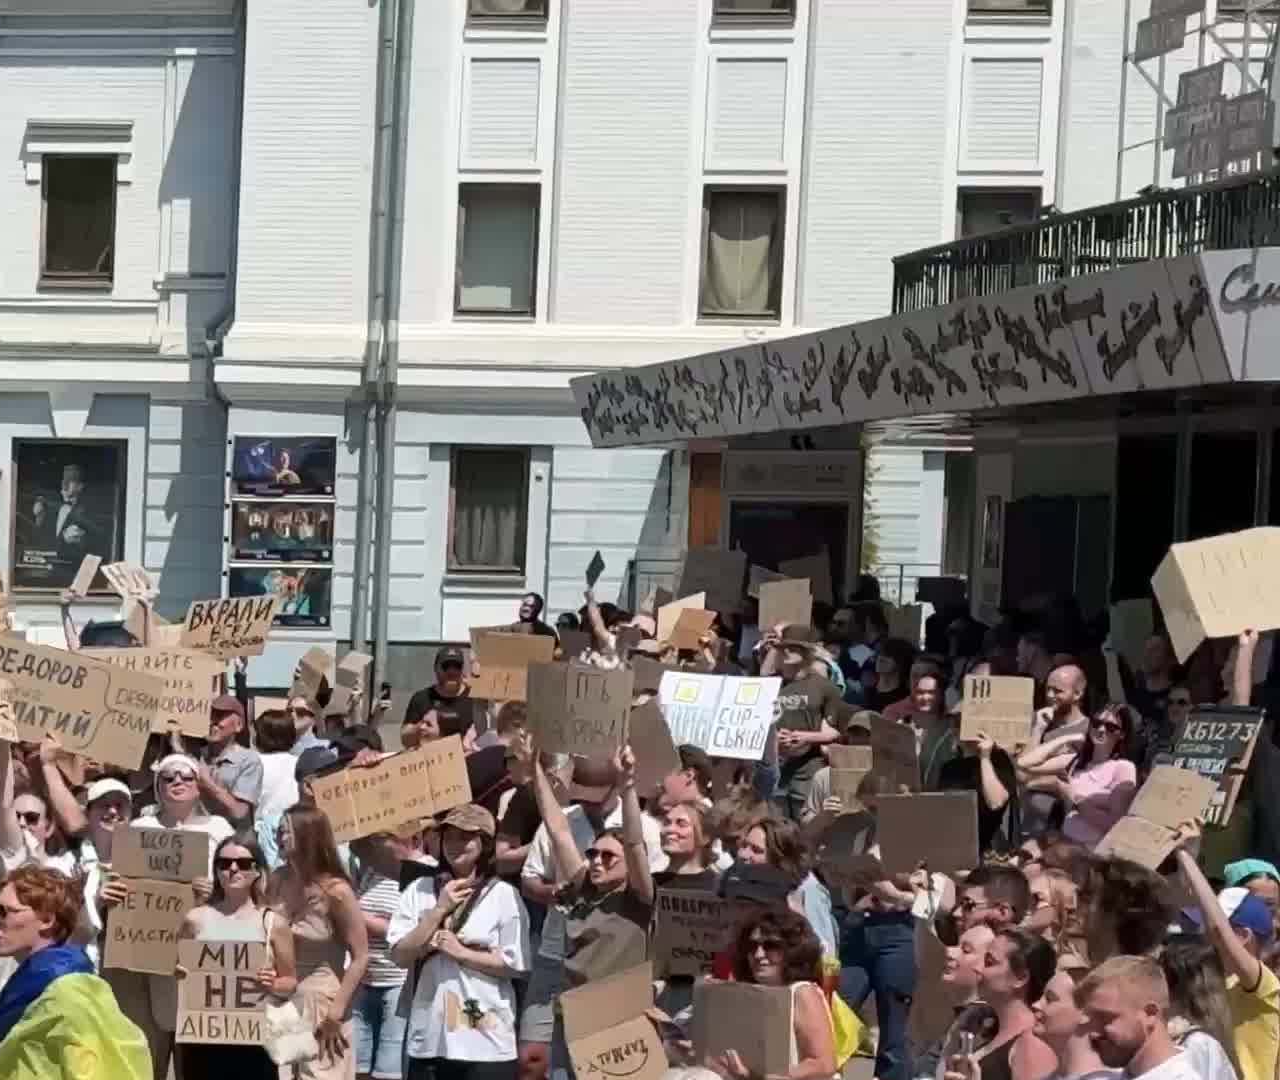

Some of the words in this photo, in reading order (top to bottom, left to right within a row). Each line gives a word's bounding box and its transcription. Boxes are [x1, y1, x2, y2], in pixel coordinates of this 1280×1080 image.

[198, 943, 249, 969] МИ
[204, 975, 258, 1009] НЕ
[179, 1015, 261, 1041] ДІБІЛИ
